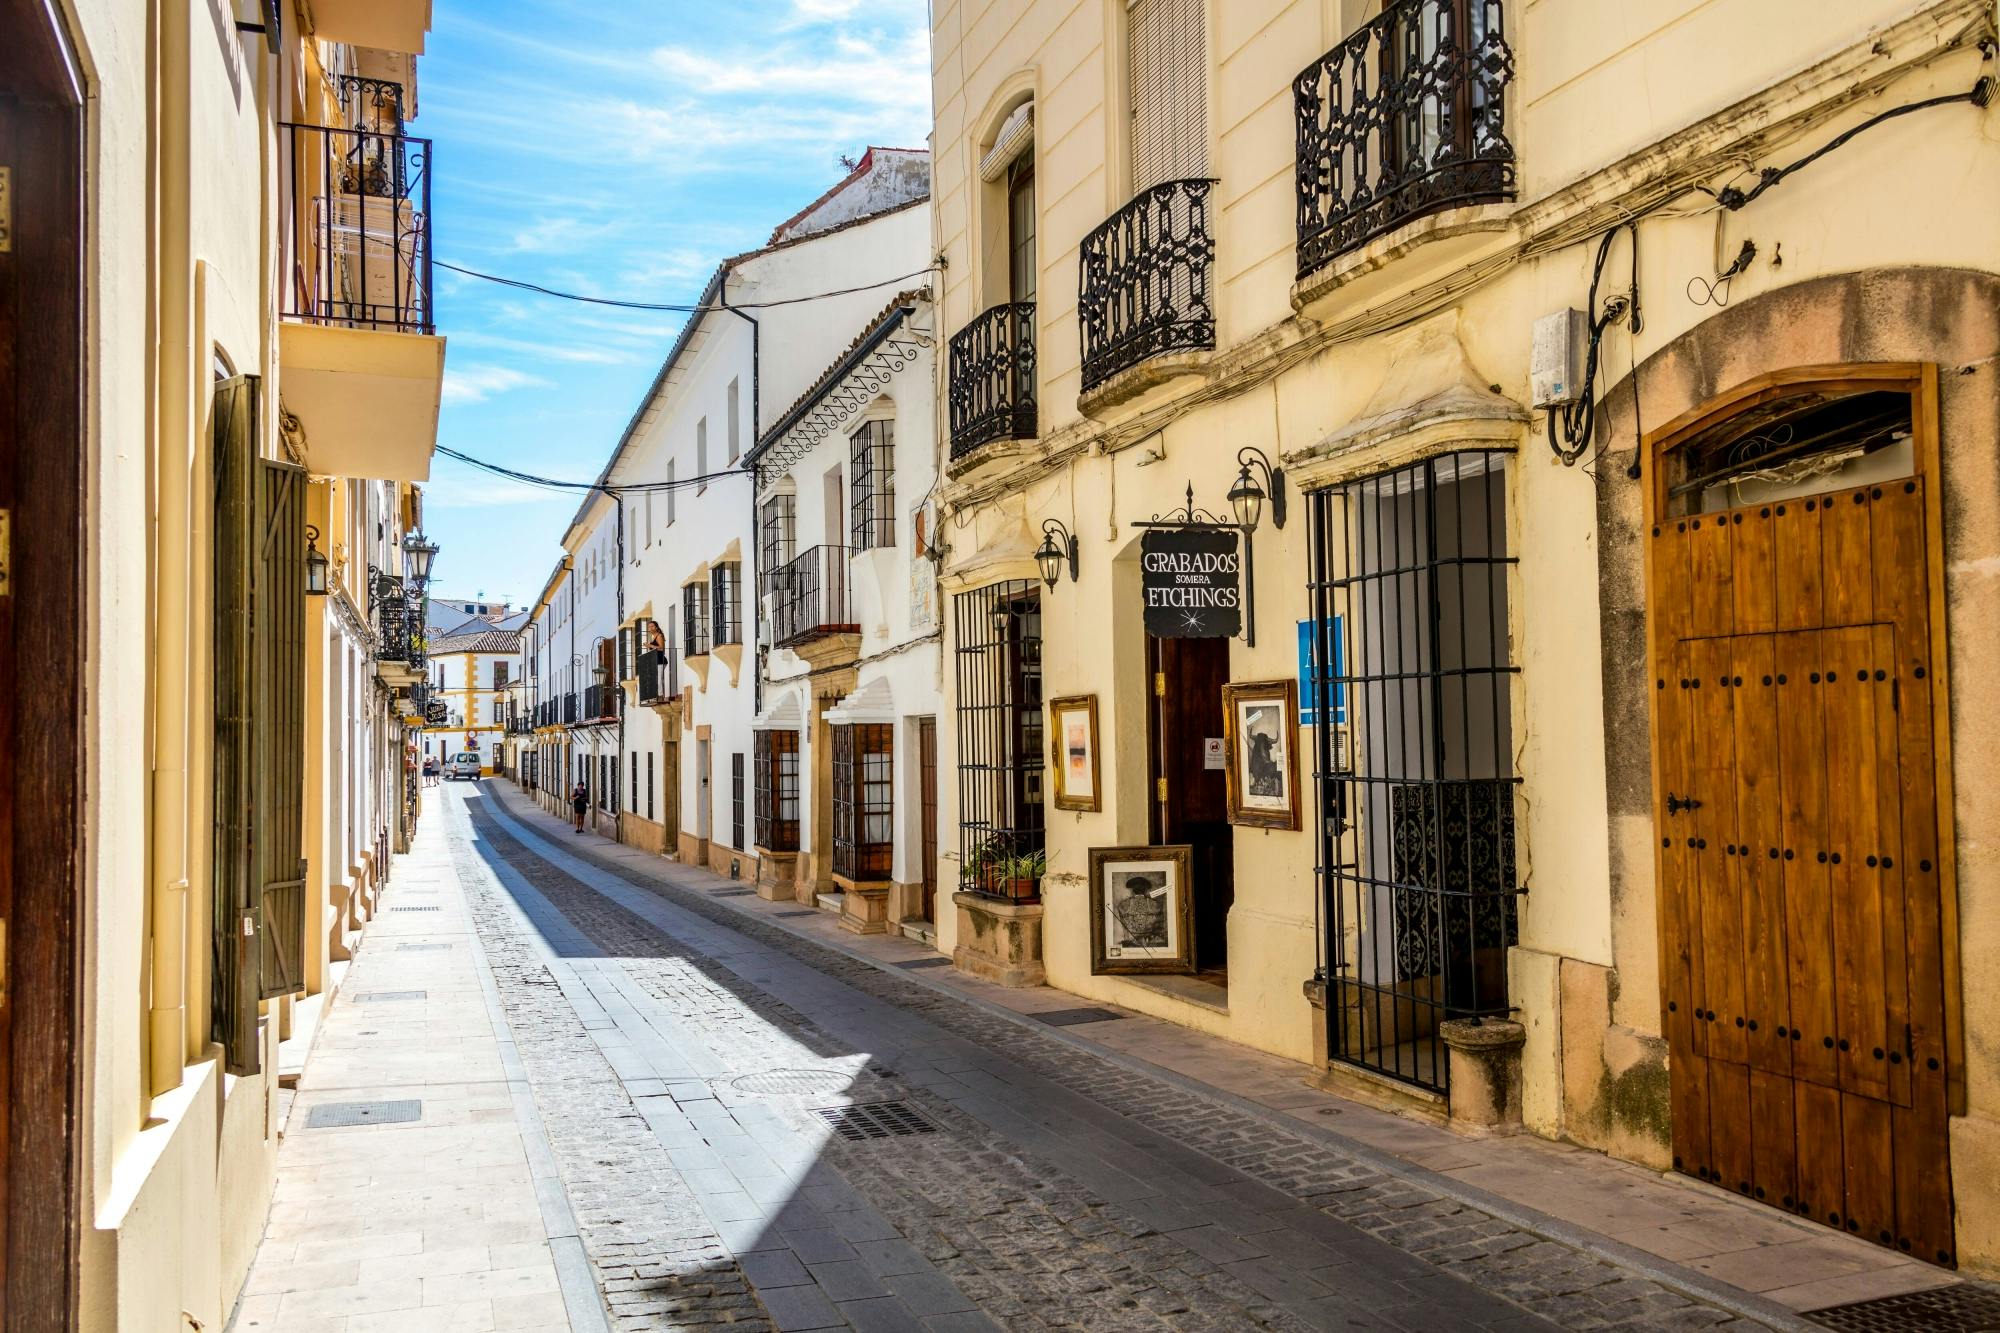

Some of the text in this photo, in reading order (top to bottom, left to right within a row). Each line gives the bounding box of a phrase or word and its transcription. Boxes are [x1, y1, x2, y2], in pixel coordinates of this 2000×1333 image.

[1144, 552, 1236, 573] GRABADOS
[1175, 574, 1211, 584] SOMERA
[1148, 587, 1237, 608] ETCHINGS
